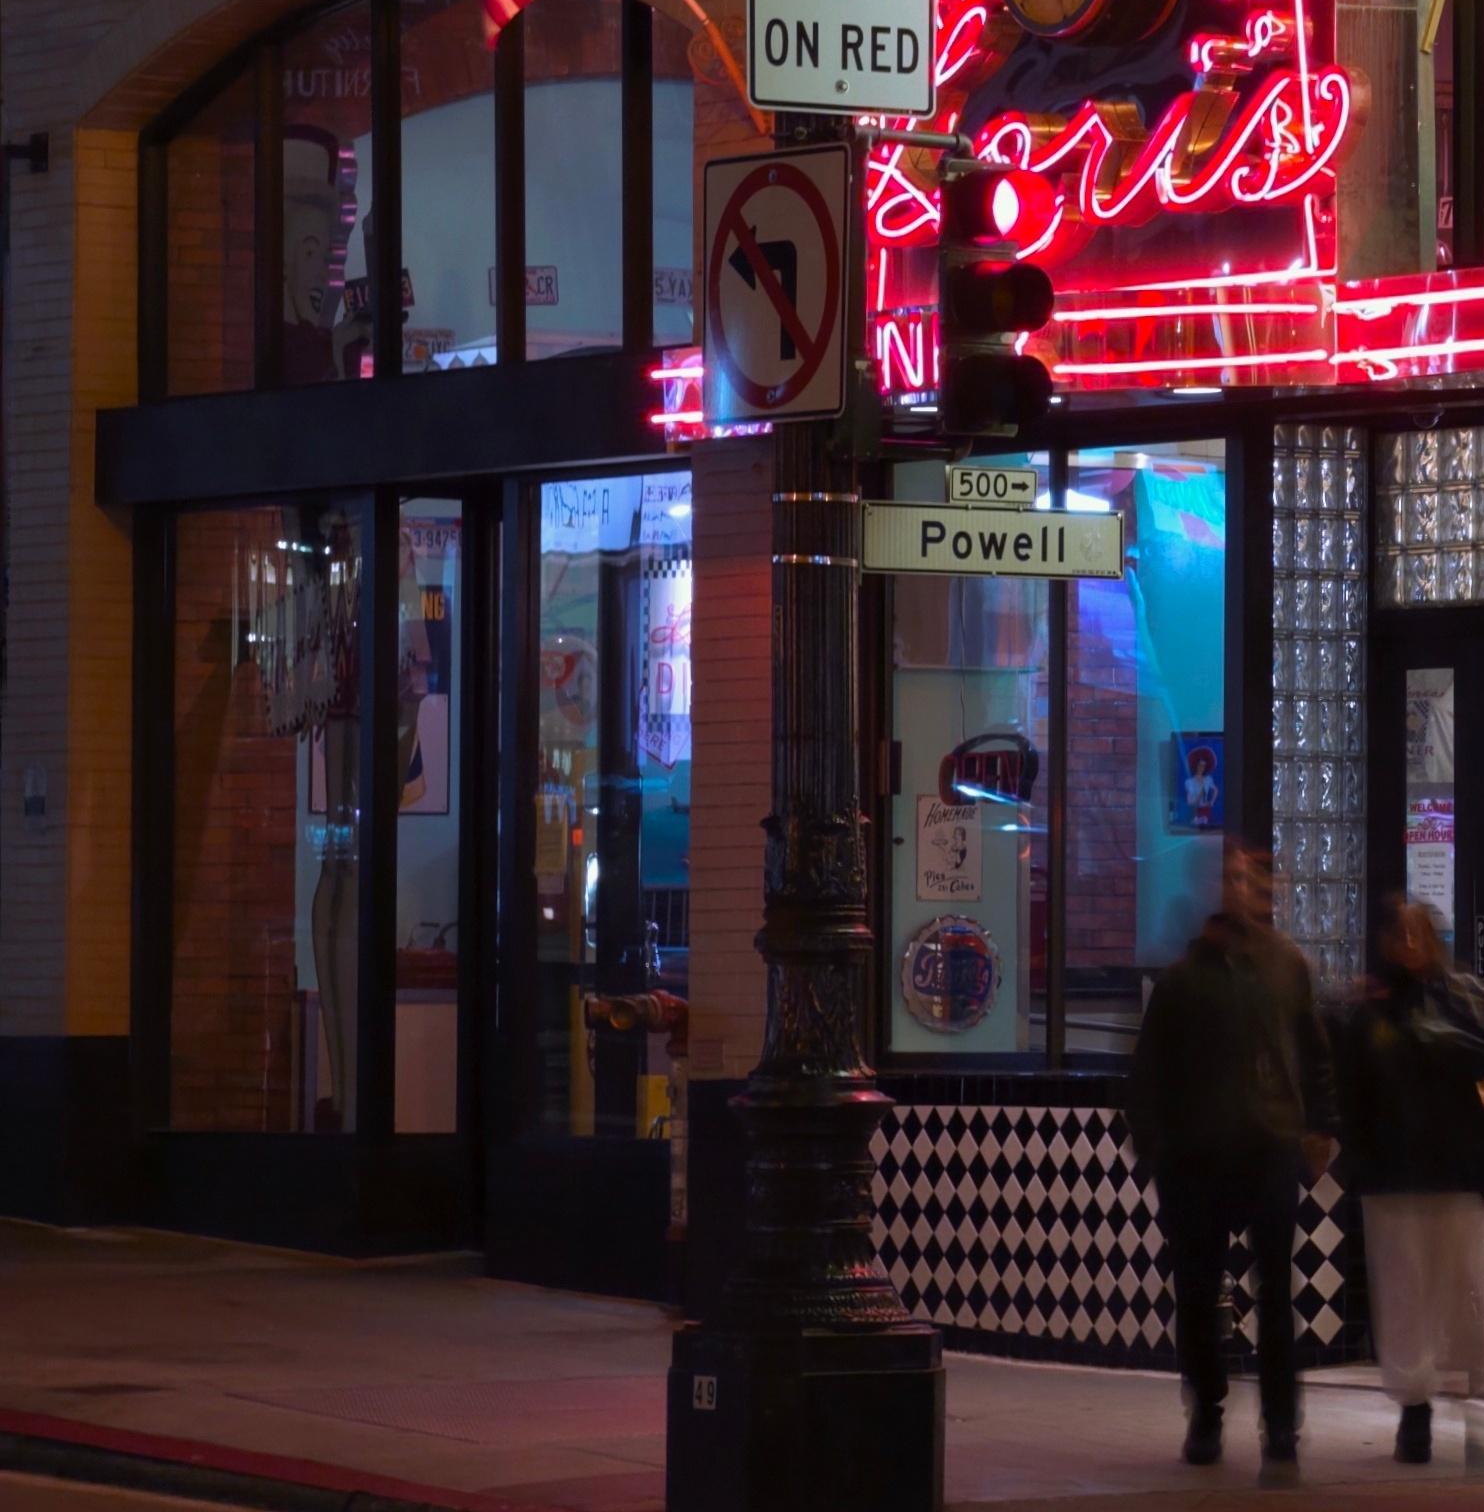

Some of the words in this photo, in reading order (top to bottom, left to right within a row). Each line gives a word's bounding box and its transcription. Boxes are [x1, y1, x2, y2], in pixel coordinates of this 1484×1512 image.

[764, 17, 819, 69] ON
[841, 23, 919, 74] RED
[959, 472, 1008, 498] 500
[921, 520, 1065, 563] Powell
